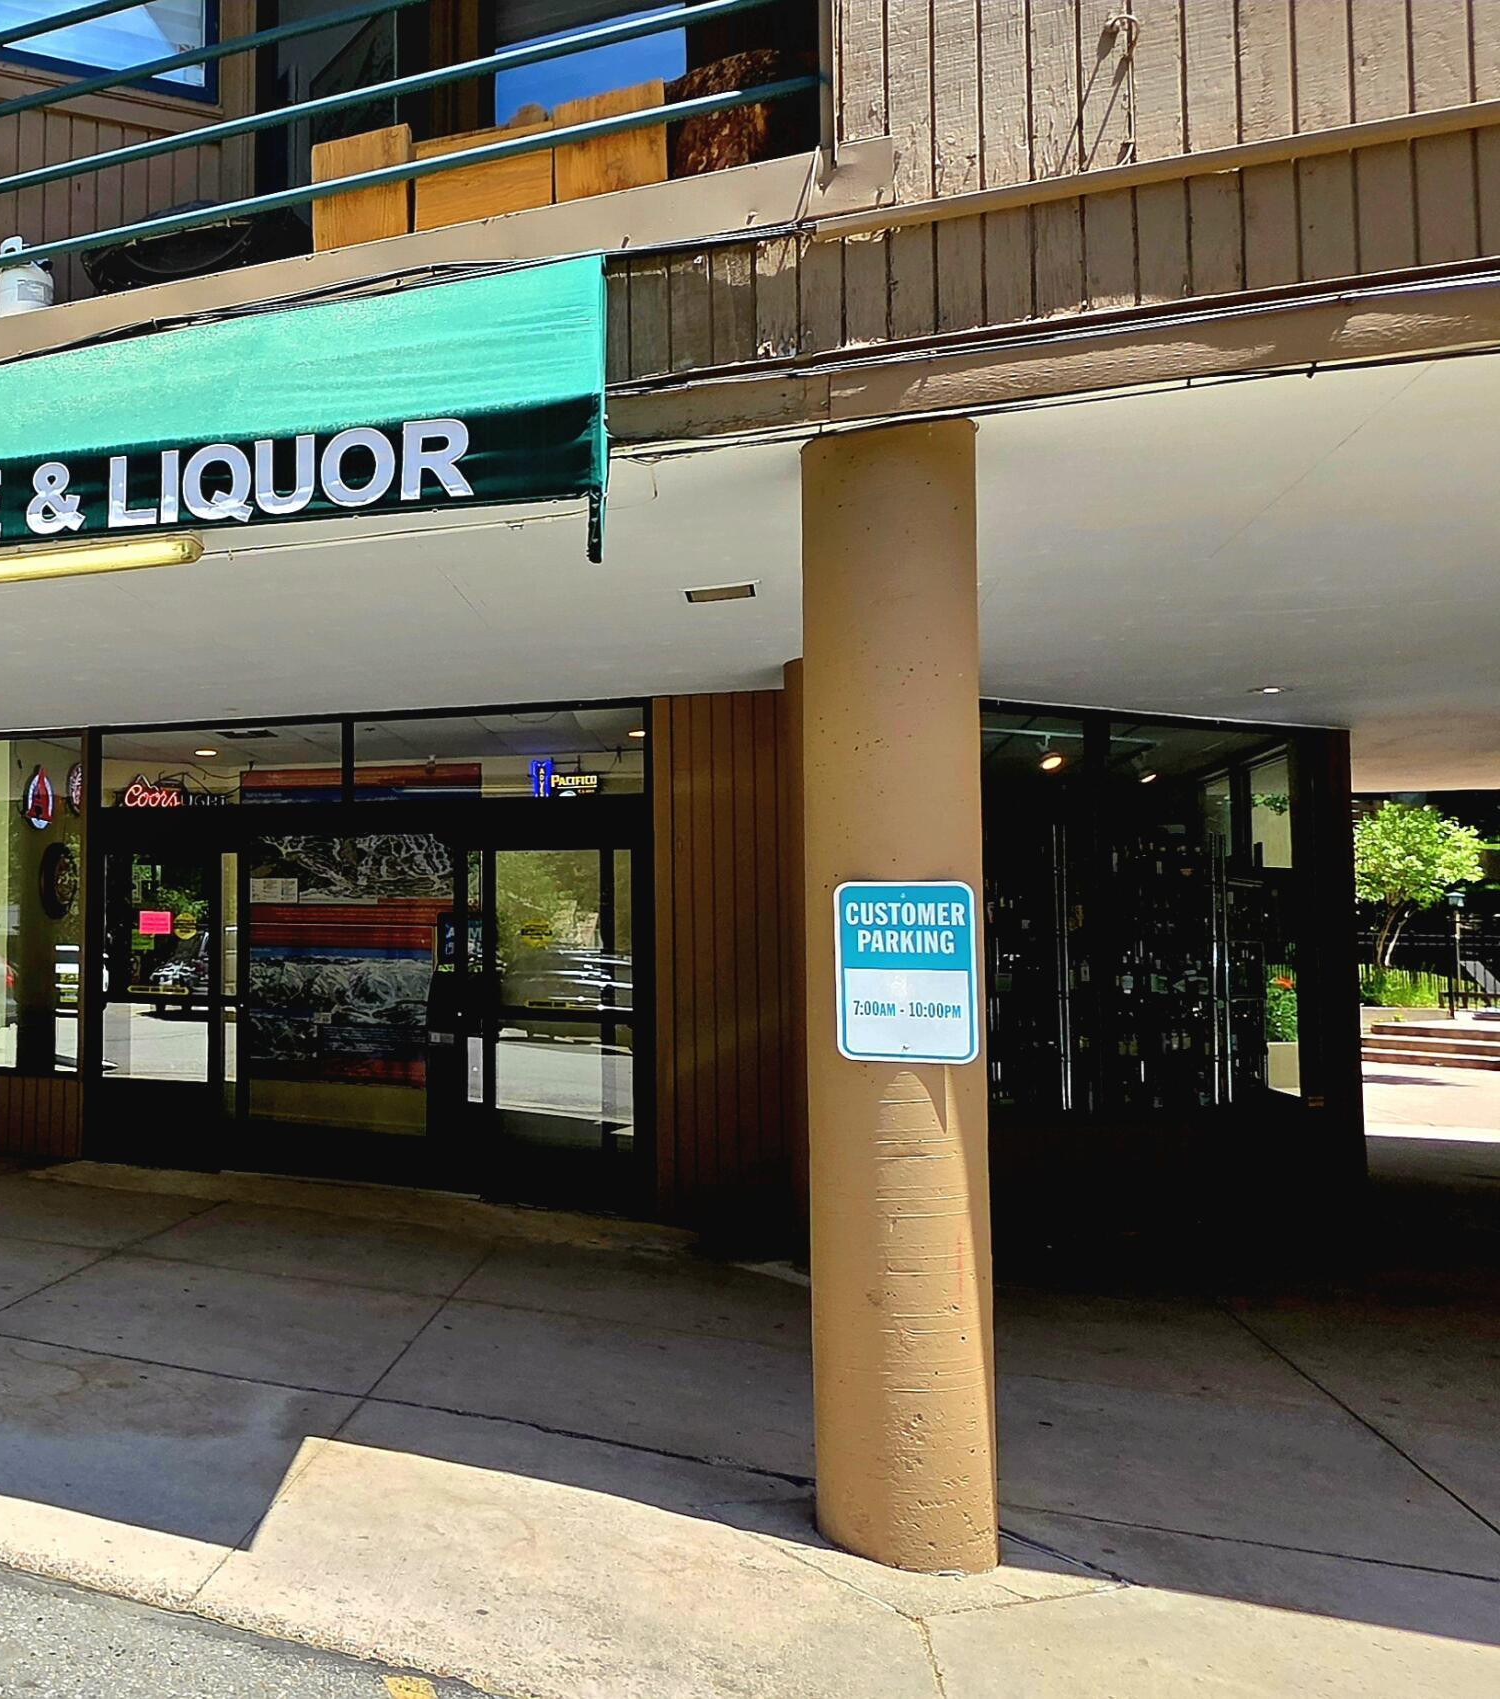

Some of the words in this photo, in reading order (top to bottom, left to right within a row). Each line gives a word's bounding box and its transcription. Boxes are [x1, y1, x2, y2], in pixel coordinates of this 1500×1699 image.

[25, 462, 87, 536] &
[107, 418, 474, 529] LIQUOR
[550, 774, 598, 788] PACIFICO
[124, 784, 181, 807] Coors
[845, 902, 966, 927] CUSTOMER
[857, 929, 955, 955] PARKING
[853, 1000, 896, 1018] 7:00AM
[909, 1002, 962, 1019] 10:00PM
